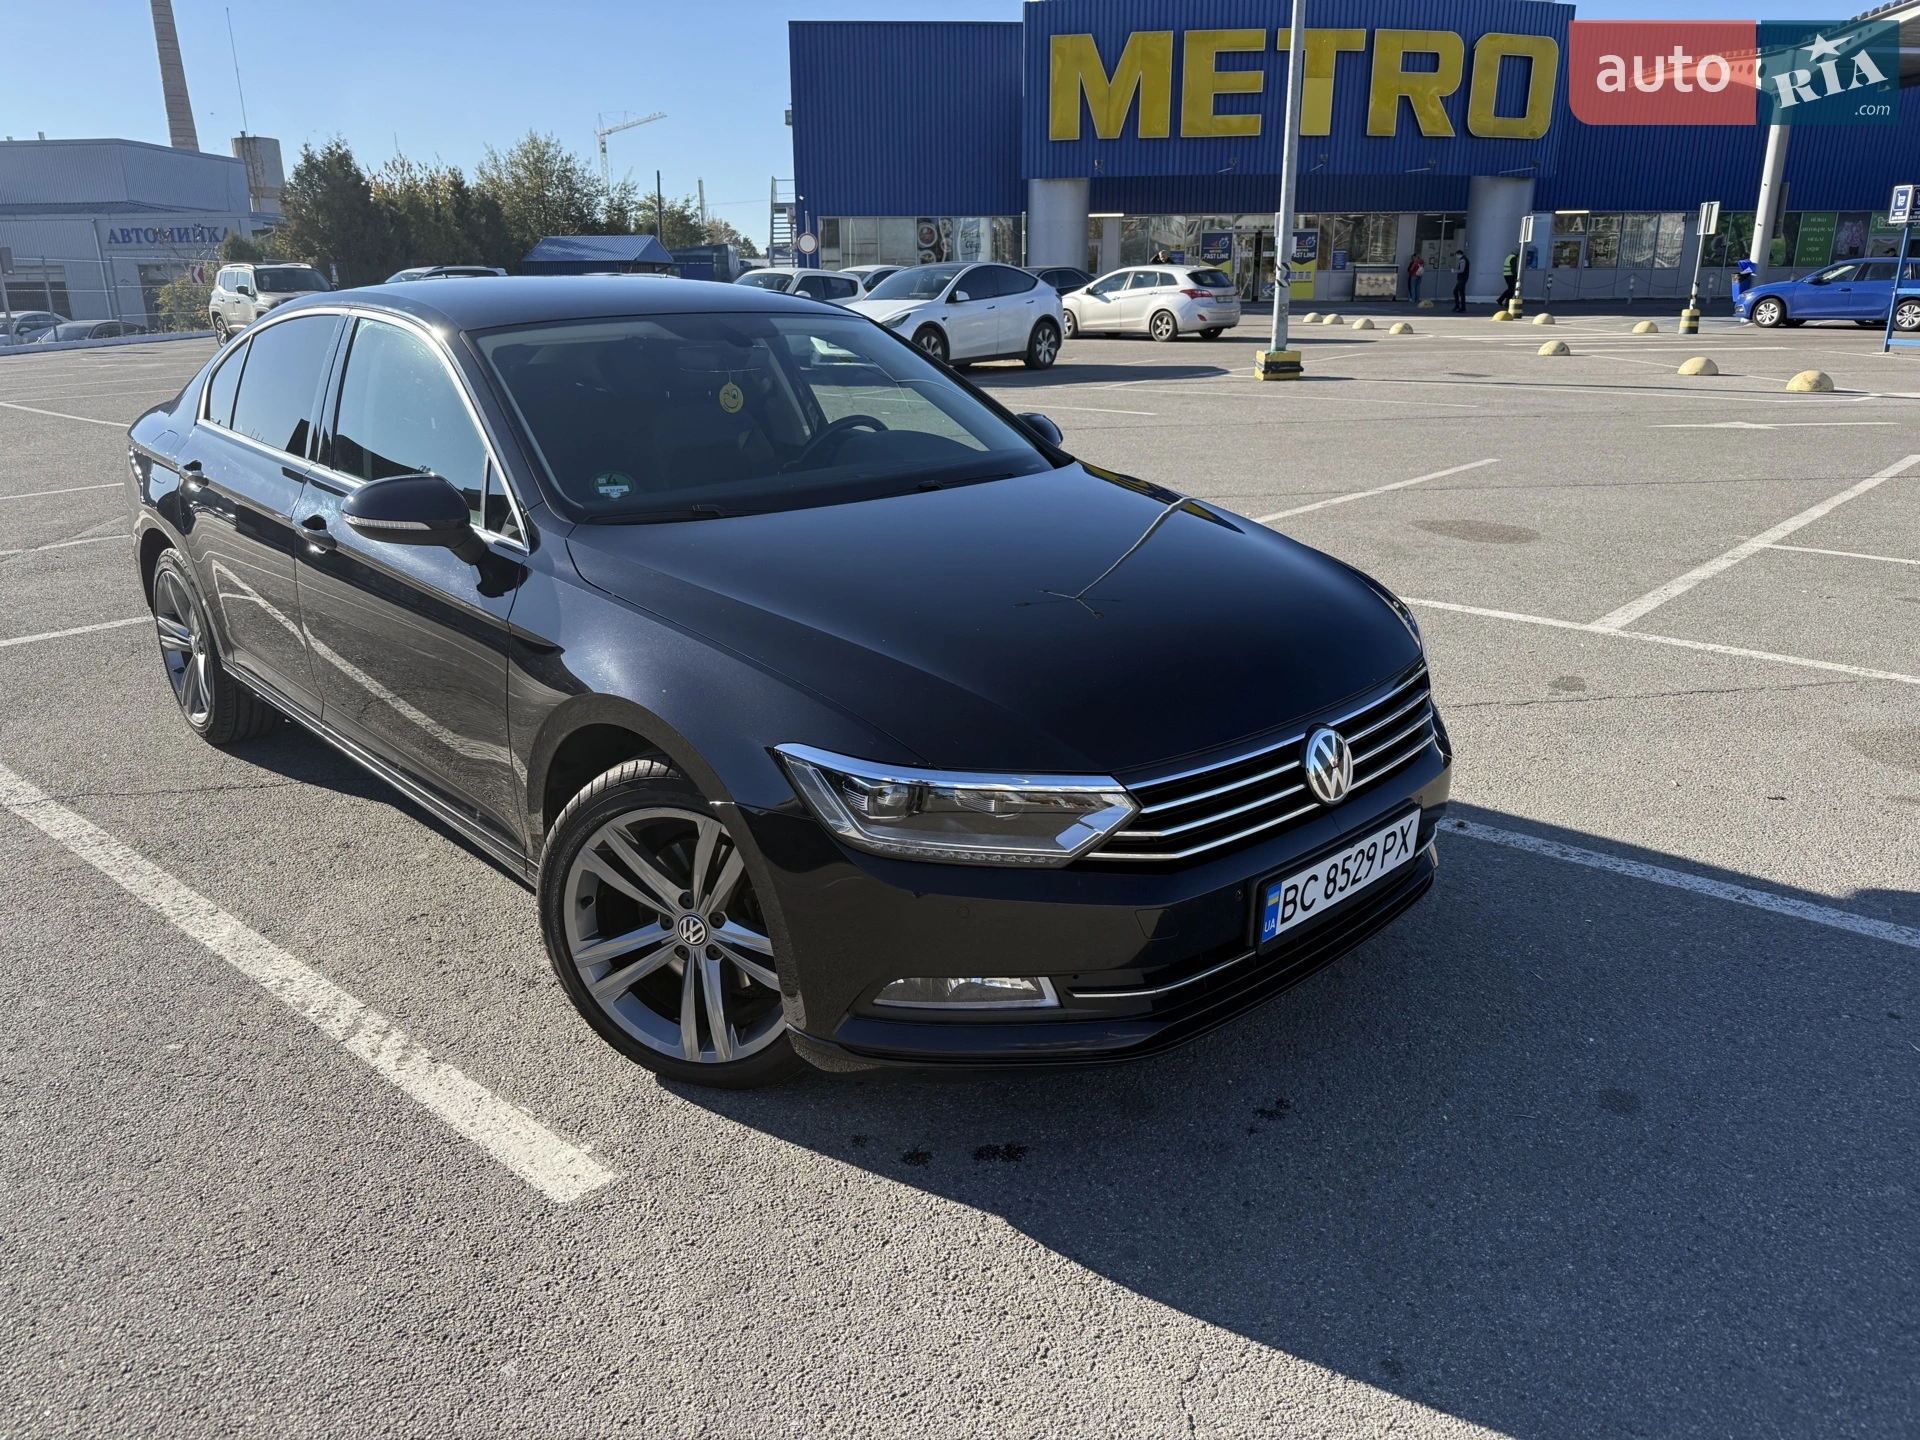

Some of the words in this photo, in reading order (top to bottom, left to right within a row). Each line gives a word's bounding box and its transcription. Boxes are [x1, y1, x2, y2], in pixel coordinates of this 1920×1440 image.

[1049, 28, 1559, 140] METRO
[1264, 917, 1276, 933] UA
[1280, 874, 1319, 925] BC
[1324, 842, 1378, 900] 8529
[1380, 819, 1414, 870] PX
